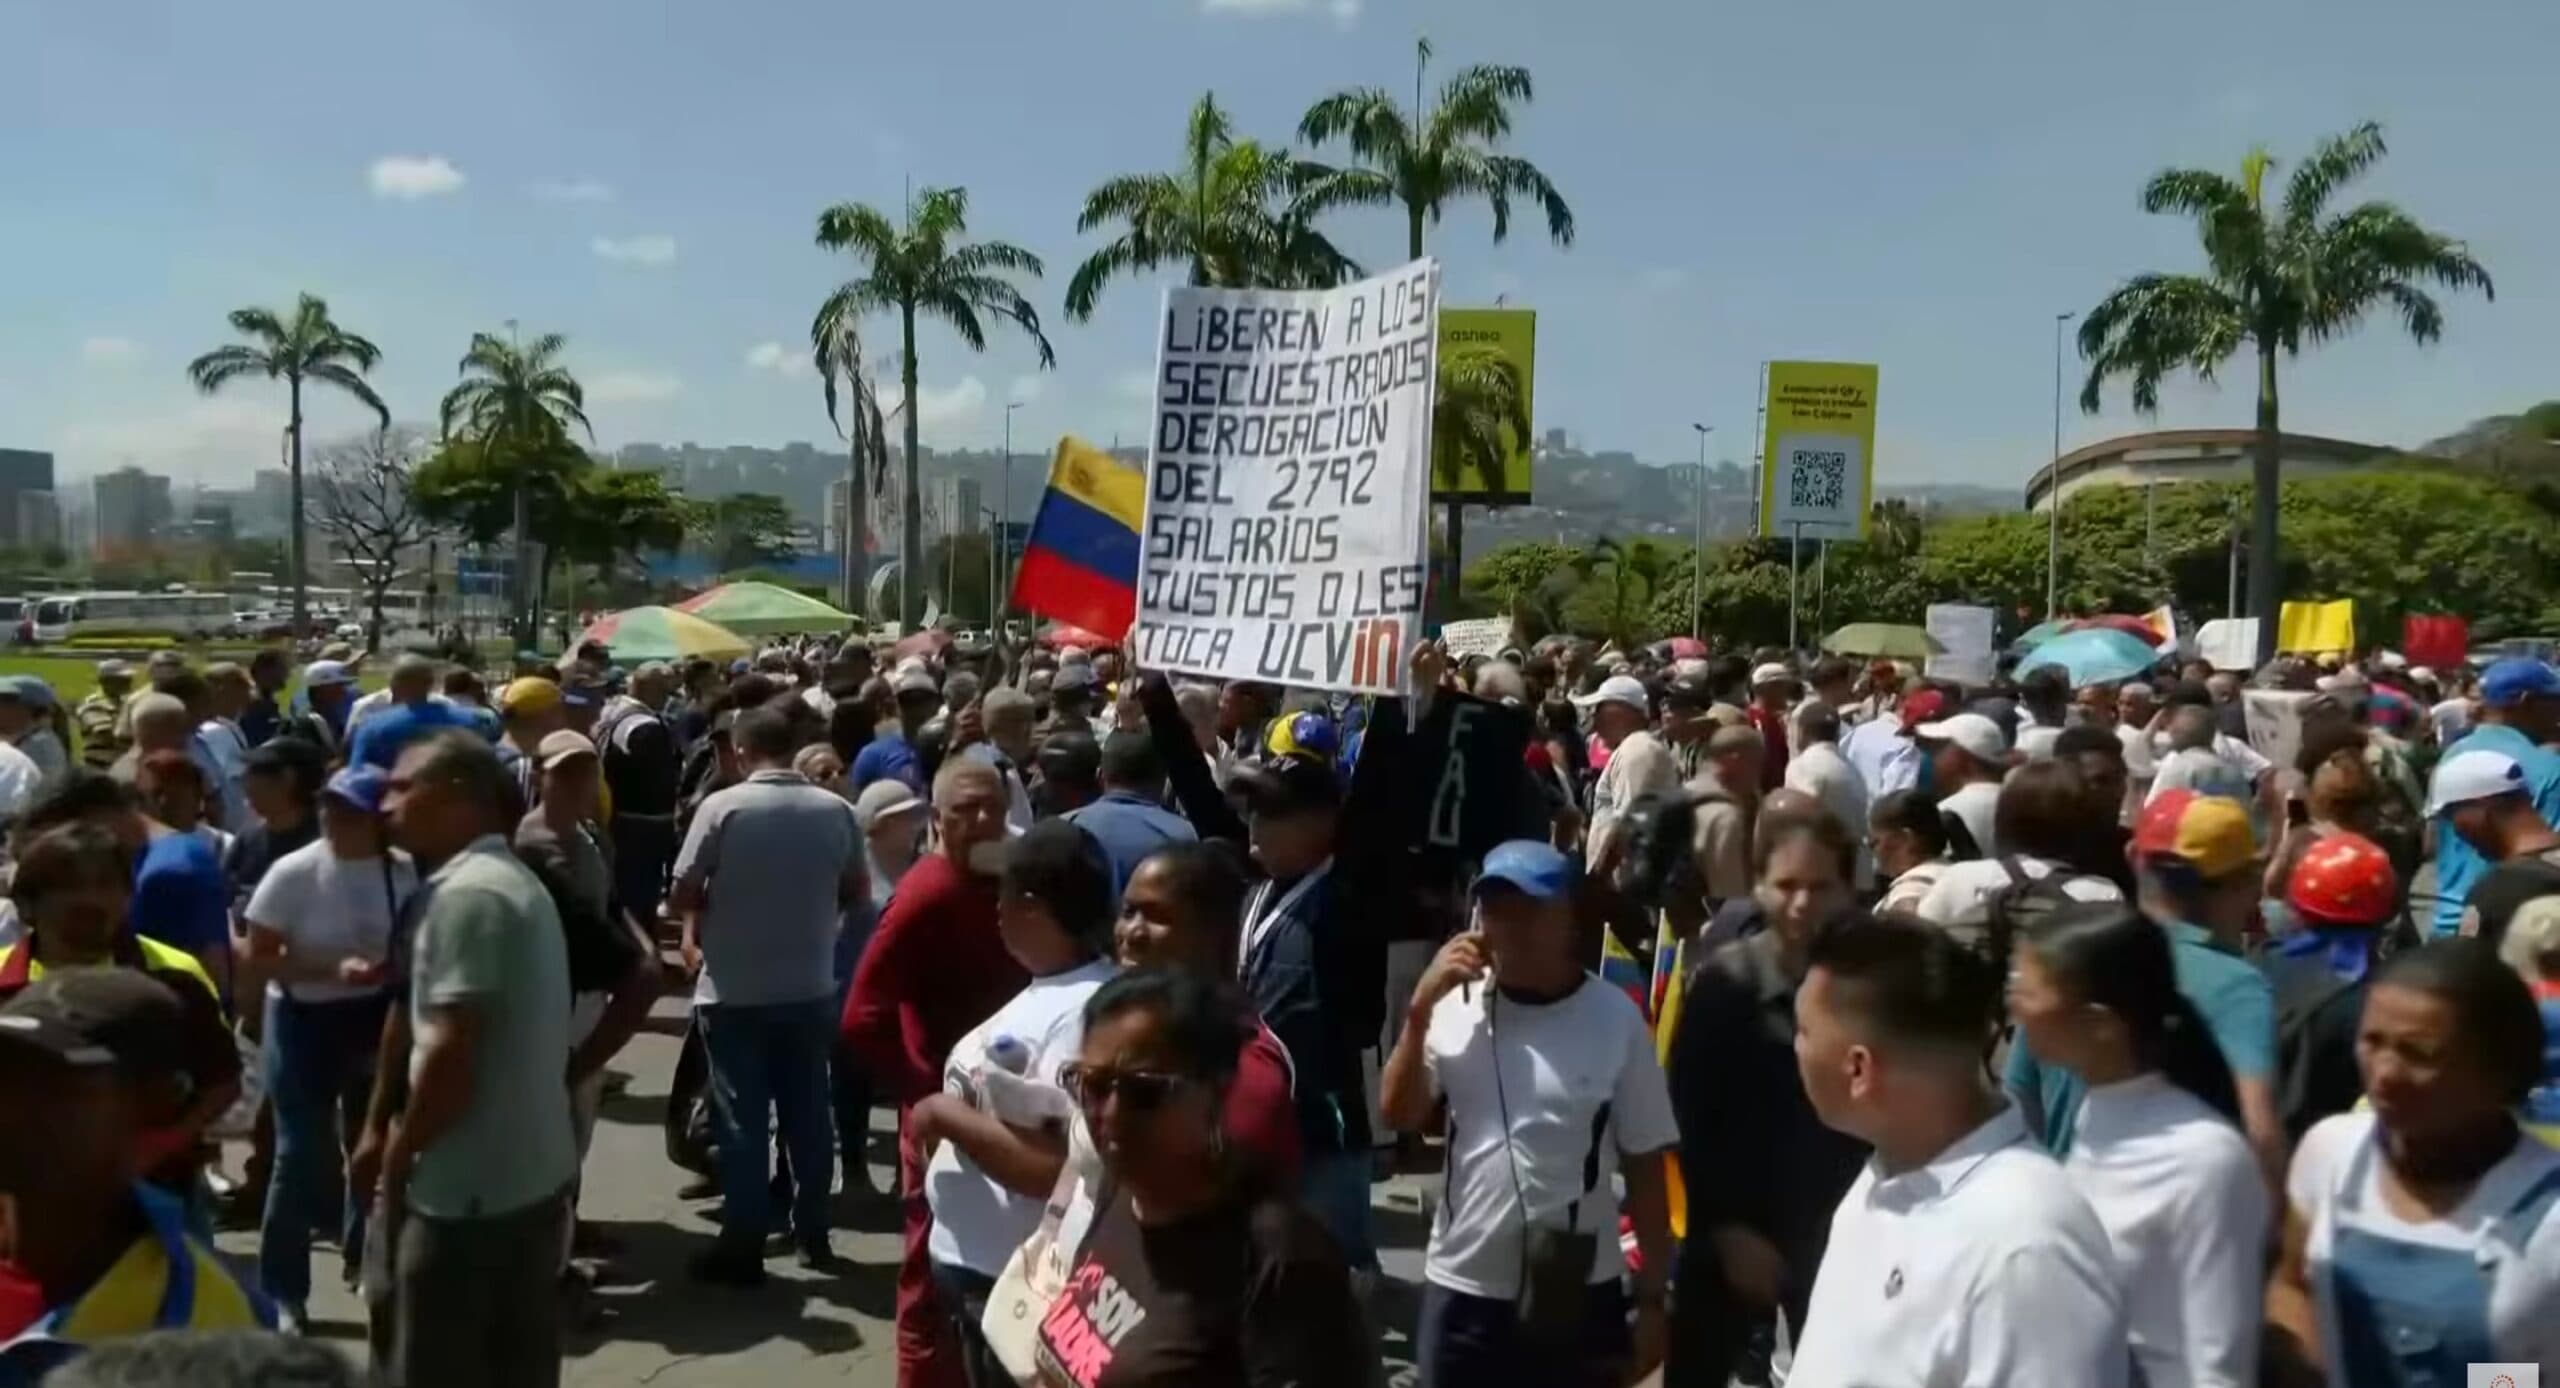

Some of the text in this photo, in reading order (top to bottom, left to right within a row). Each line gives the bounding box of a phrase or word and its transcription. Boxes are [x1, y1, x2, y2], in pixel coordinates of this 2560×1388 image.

[1346, 295, 1366, 346] A
[1379, 273, 1427, 336] LOS
[1164, 335, 1429, 406] SECUESTRADOS
[1155, 450, 1378, 512] DEL 2792
[1143, 568, 1297, 621] JUSTOS
[1142, 621, 1232, 669] TOCA
[1085, 1275, 1148, 1349] SOY
